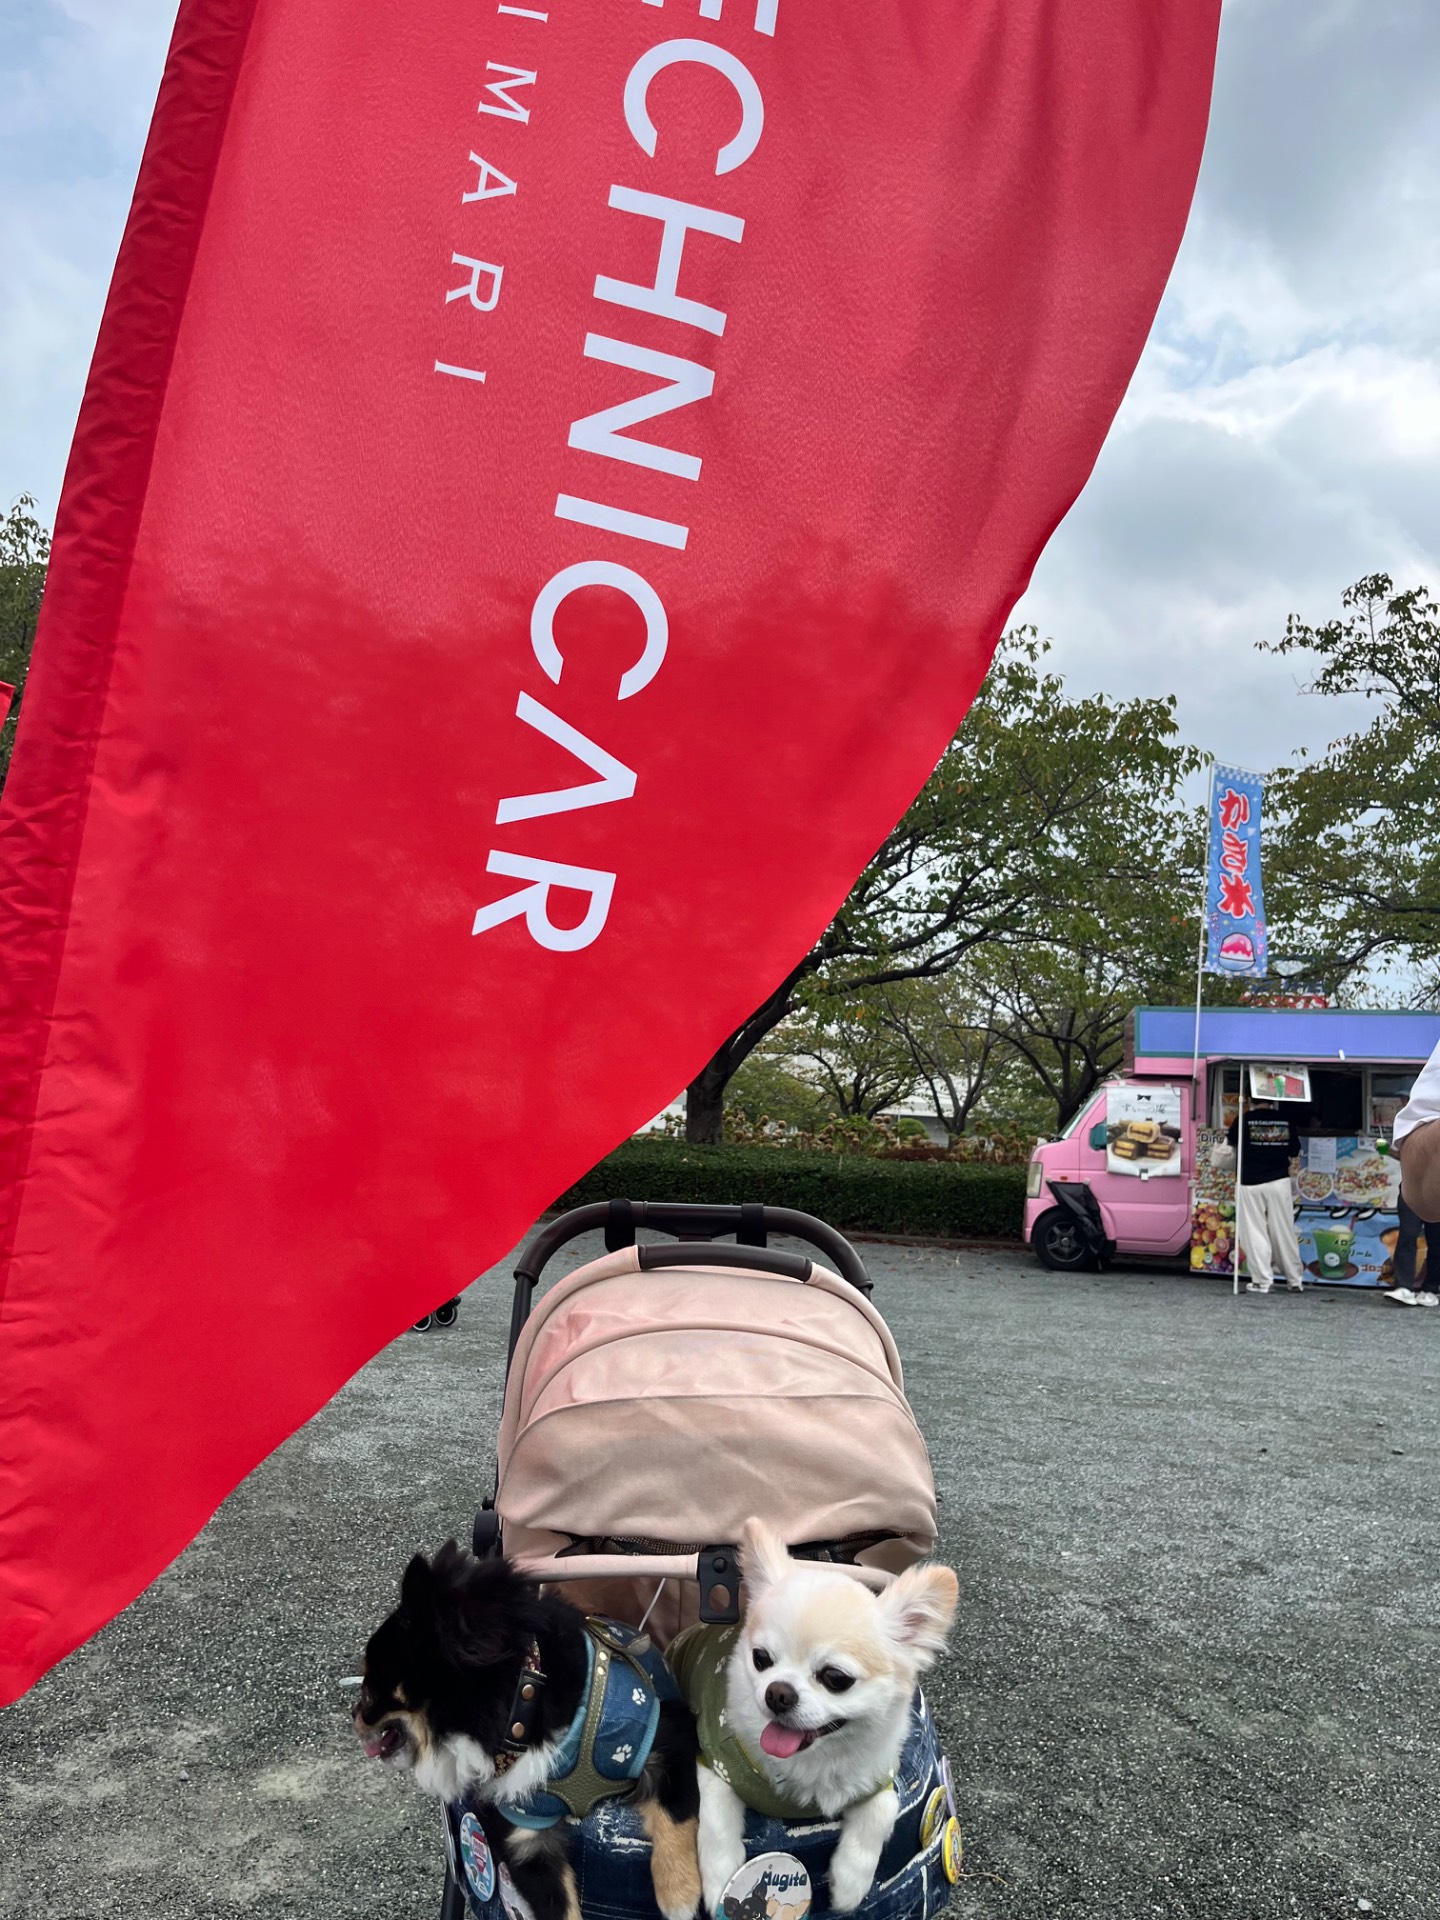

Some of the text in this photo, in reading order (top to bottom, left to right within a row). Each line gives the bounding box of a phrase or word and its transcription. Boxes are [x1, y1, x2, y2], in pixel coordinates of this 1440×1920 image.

[1218, 787, 1255, 919] かき氷
[761, 1871, 808, 1892] Mugita
